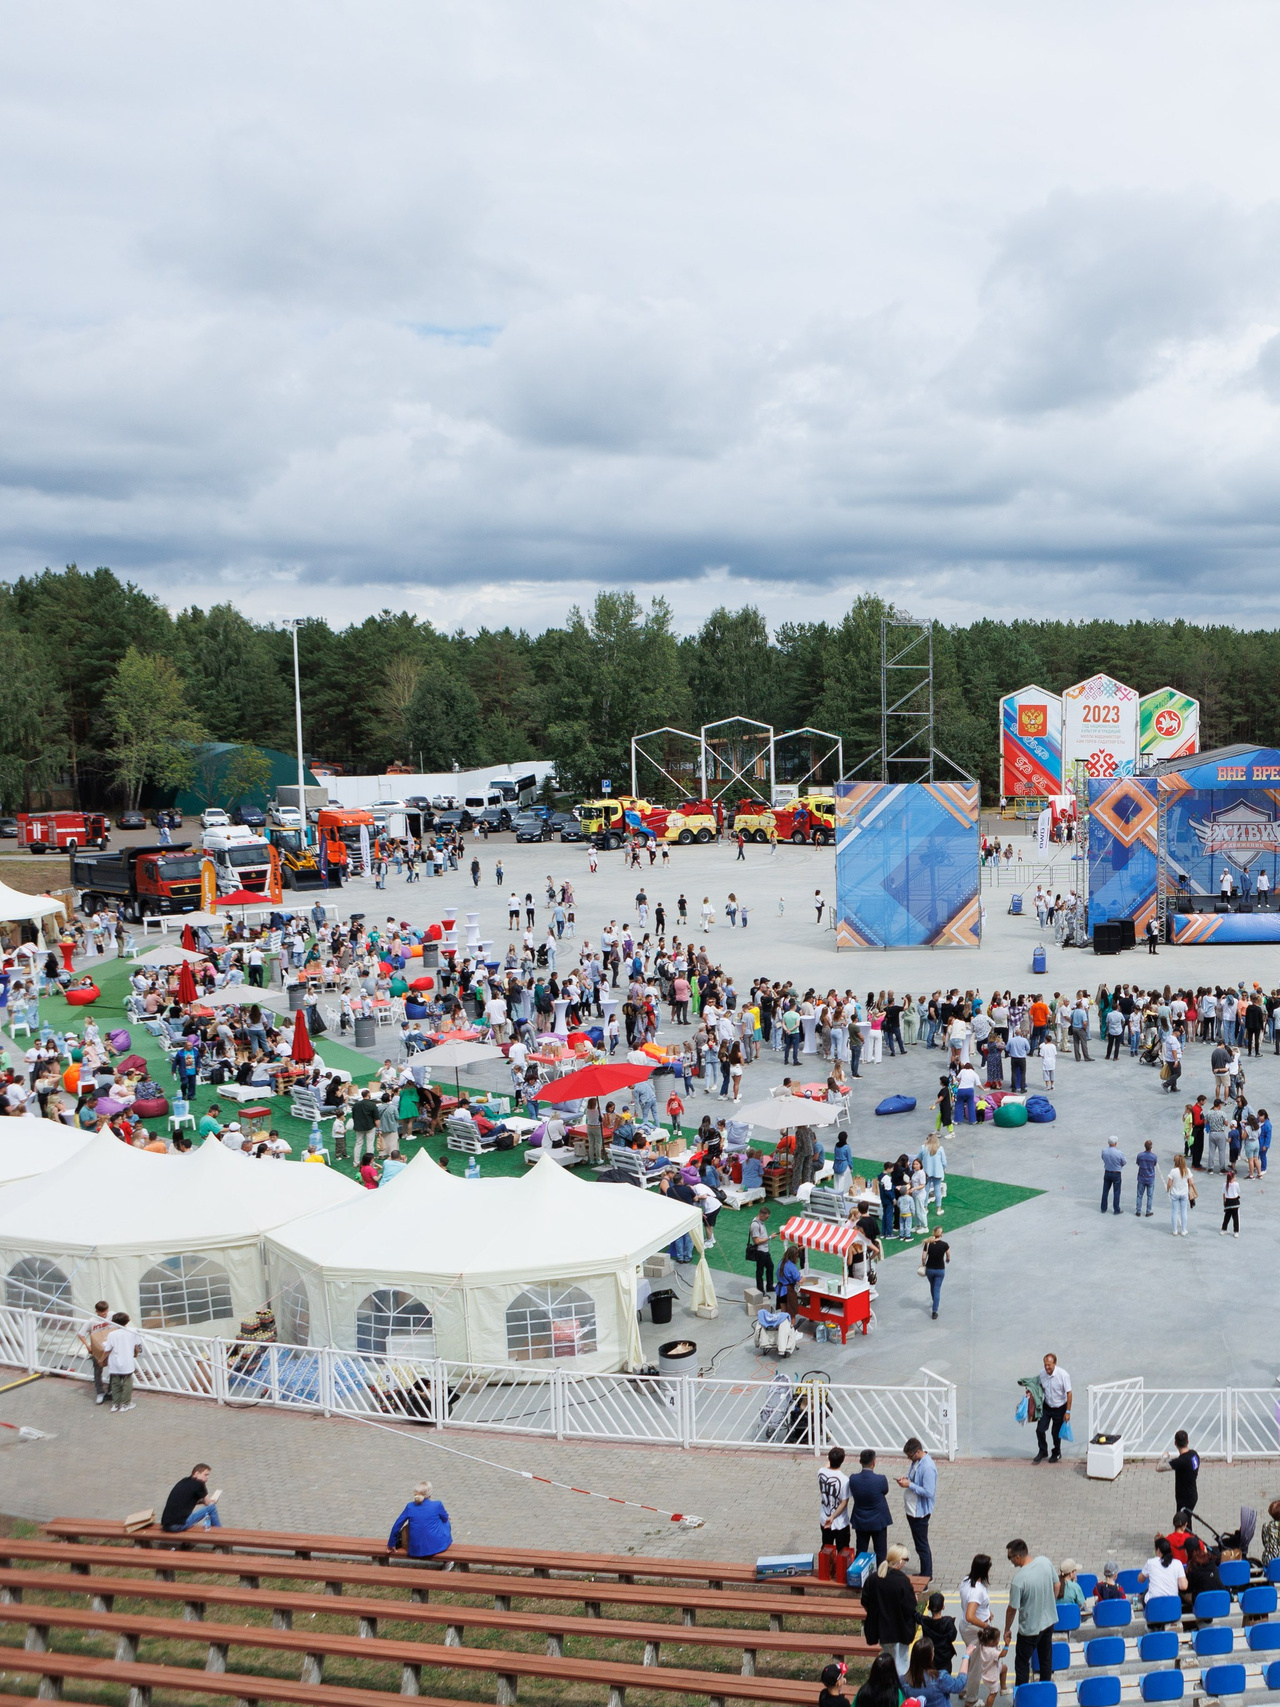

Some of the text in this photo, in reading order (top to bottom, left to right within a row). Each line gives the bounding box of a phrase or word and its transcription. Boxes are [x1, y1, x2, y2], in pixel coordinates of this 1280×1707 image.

[1082, 704, 1120, 723] 2023
[1217, 766, 1246, 781] ВНЕ
[1207, 823, 1276, 842] ЖИВИ
[942, 1409, 948, 1418] 3
